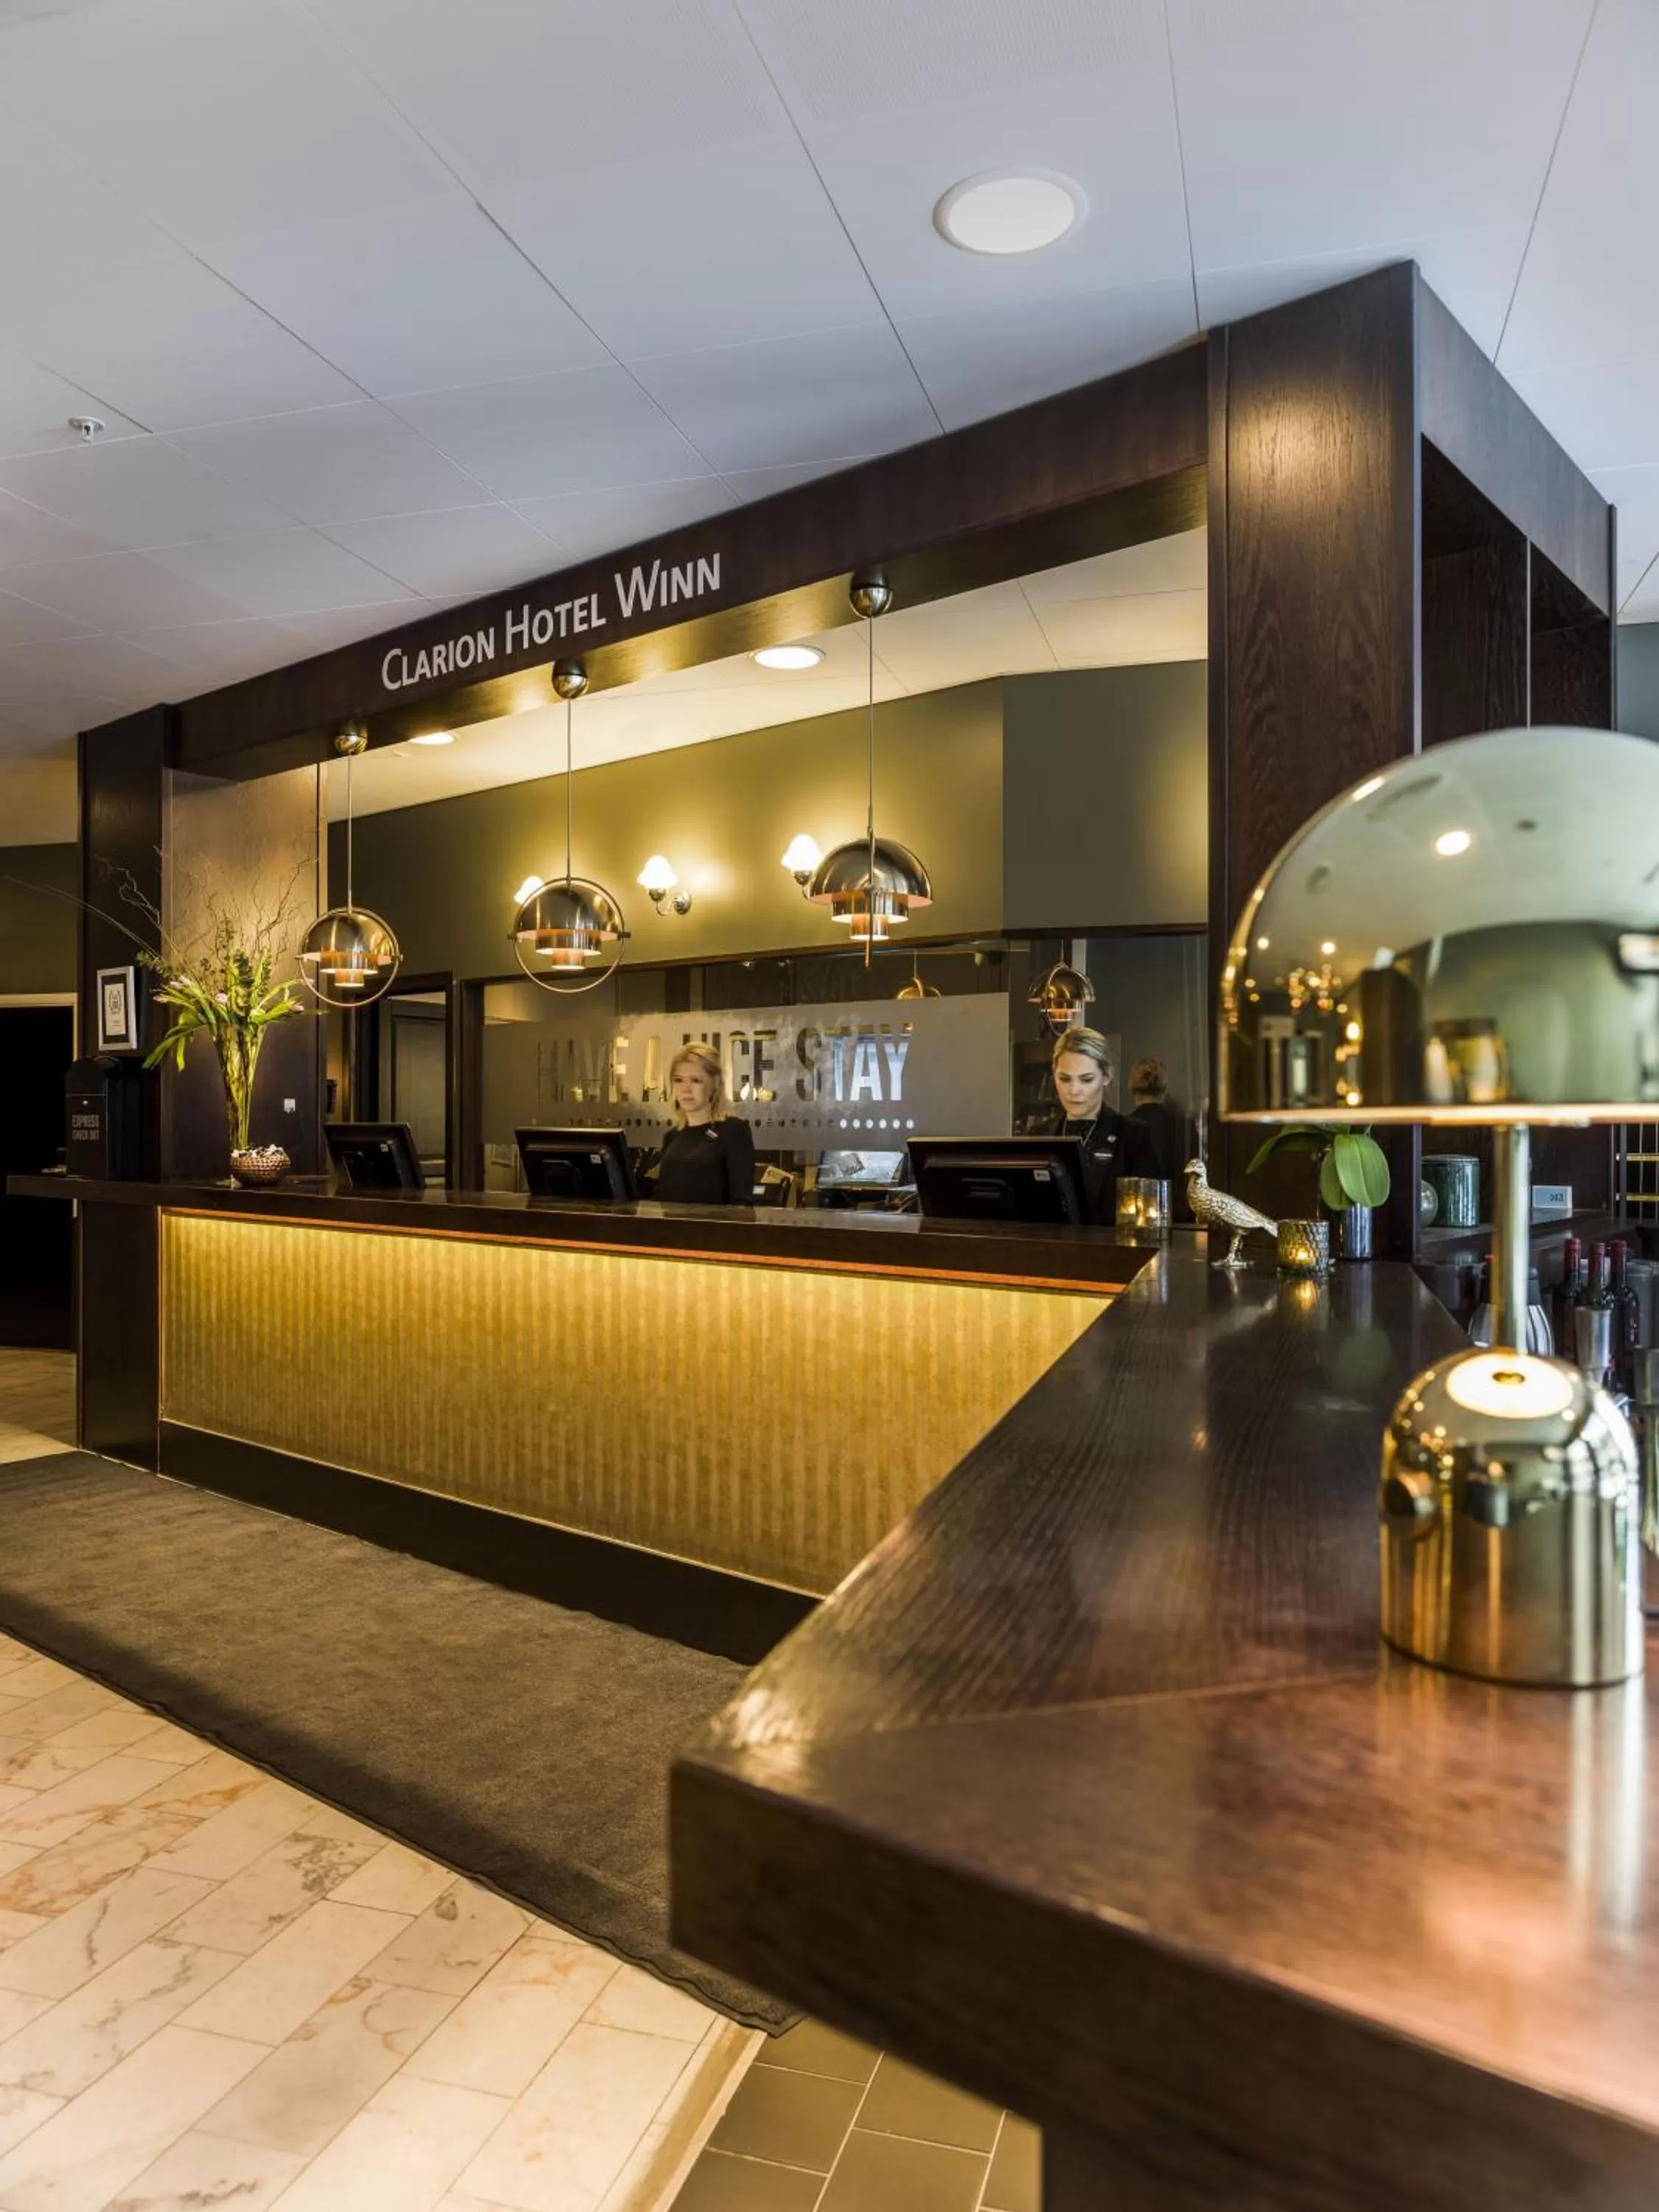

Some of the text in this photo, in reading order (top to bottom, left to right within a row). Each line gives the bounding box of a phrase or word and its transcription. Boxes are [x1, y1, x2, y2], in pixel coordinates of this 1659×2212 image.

[381, 552, 722, 691] CLARION HOTEL WINN
[795, 1023, 912, 1103] STAY
[72, 1114, 100, 1127] EXPRESS
